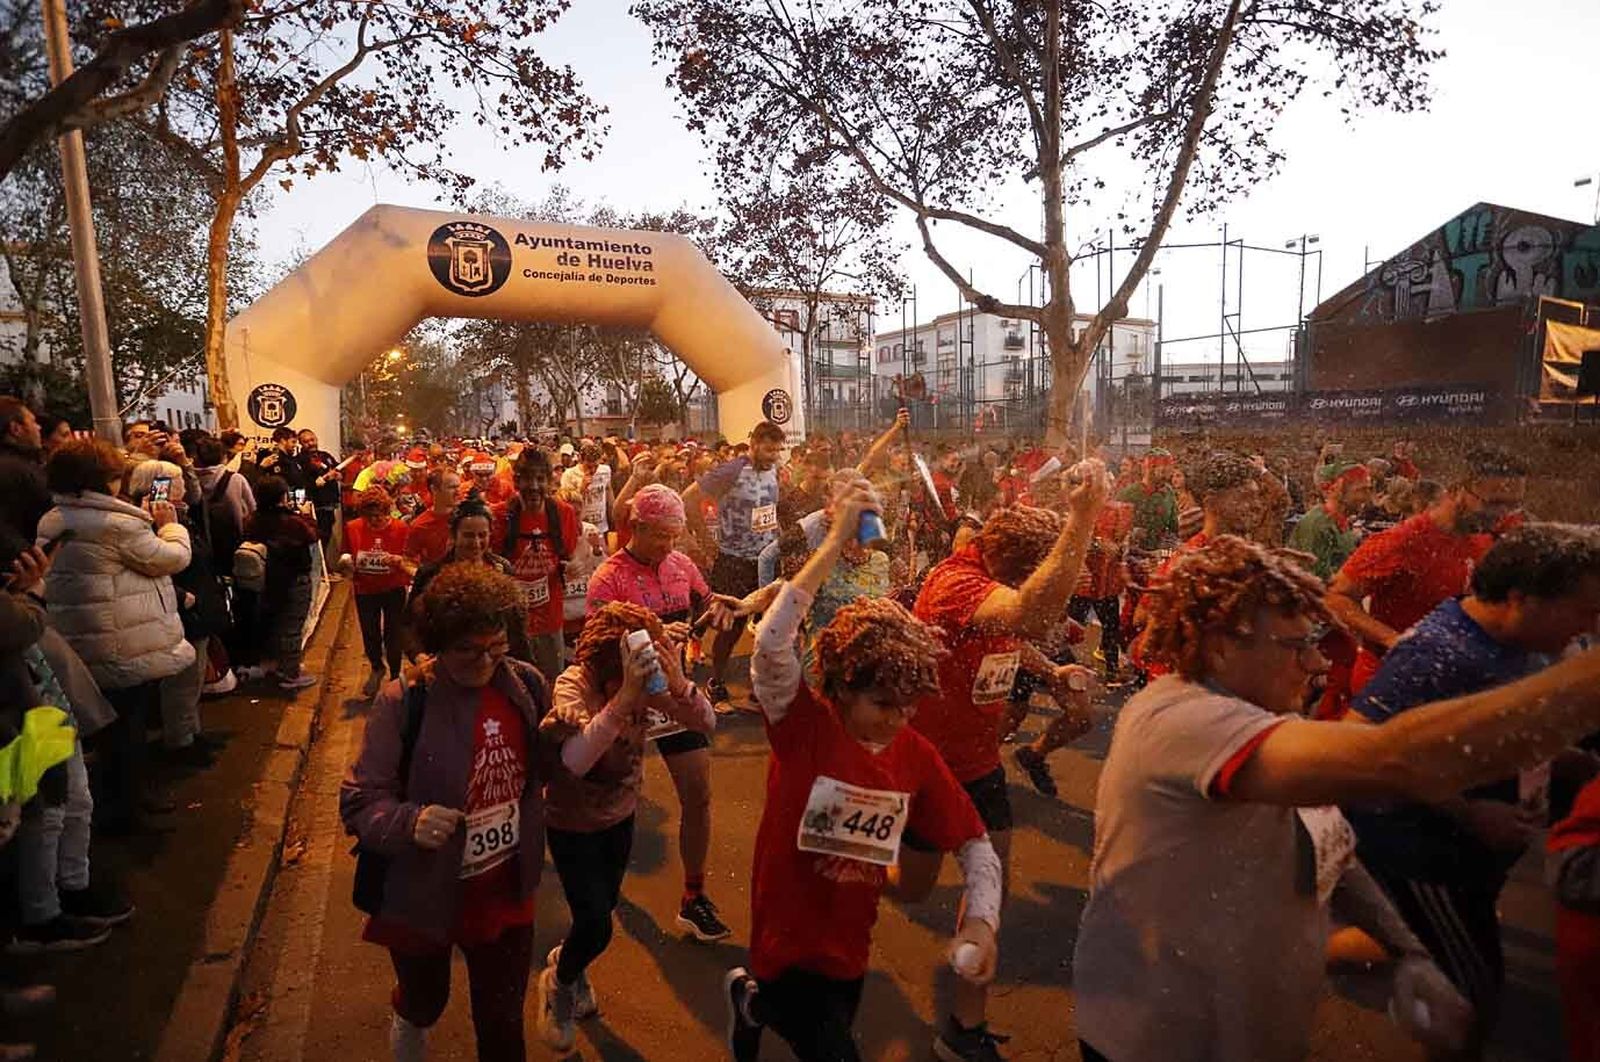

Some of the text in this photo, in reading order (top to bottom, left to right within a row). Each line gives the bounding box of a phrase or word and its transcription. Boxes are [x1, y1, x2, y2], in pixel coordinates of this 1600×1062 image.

[514, 233, 652, 255] Ayuntamiento
[557, 251, 654, 272] de Huelva
[589, 273, 603, 283] de
[606, 273, 656, 286] Deportes
[1329, 397, 1382, 408] HYUNDAI
[1421, 391, 1485, 405] HYUNDAI
[842, 809, 895, 841] 448
[470, 821, 514, 857] 398
